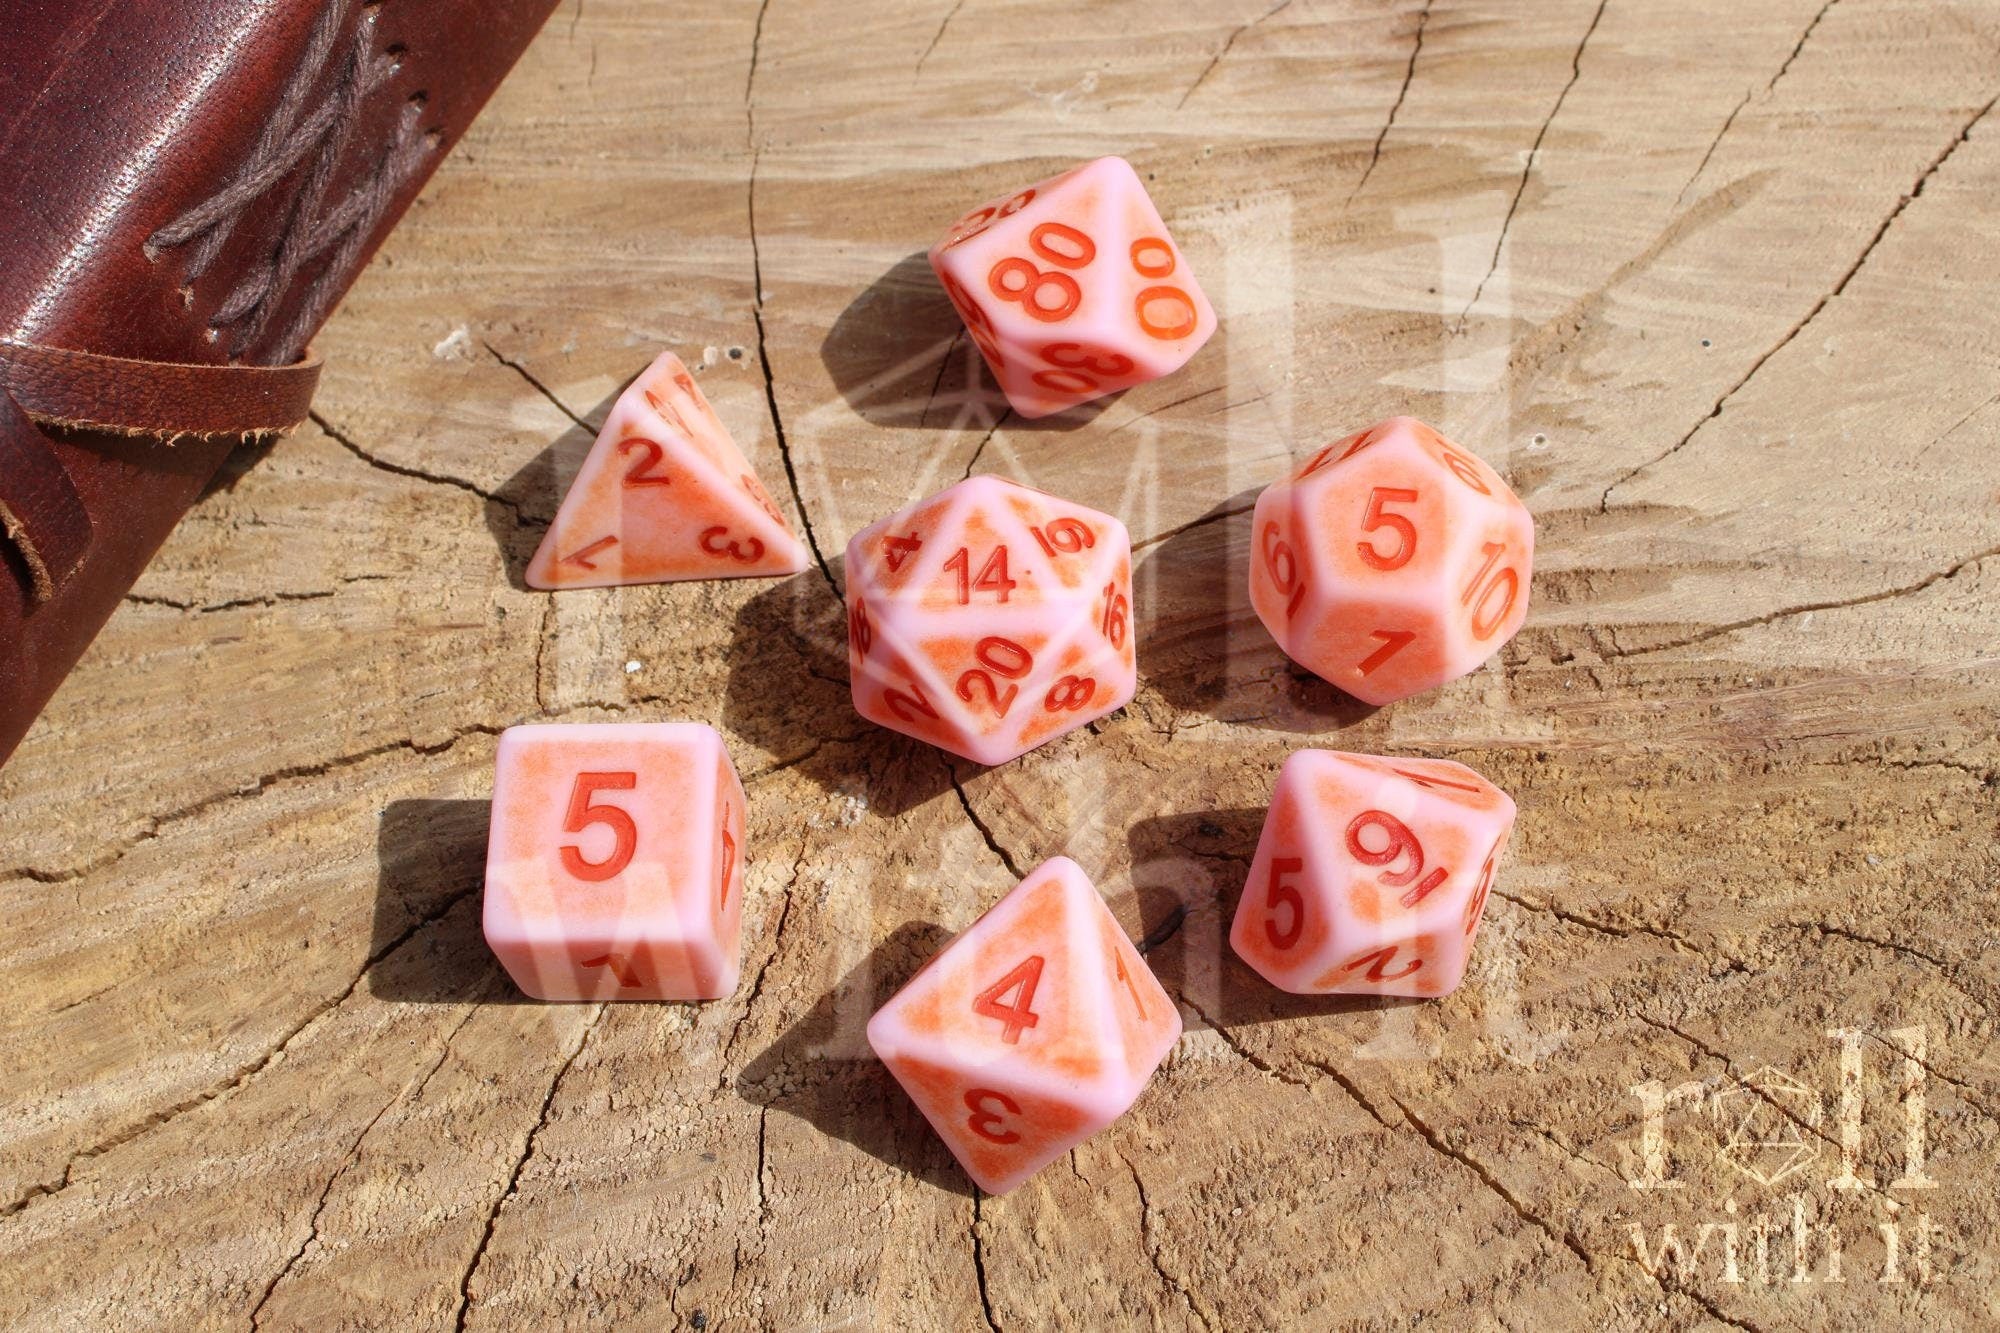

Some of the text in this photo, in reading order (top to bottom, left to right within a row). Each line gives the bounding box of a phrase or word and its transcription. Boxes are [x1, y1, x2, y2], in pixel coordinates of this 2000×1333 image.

[988, 222, 1097, 323] 80
[1130, 237, 1198, 340] 00
[1032, 342, 1134, 393] 30
[617, 437, 671, 488] 2
[560, 535, 619, 571] 1
[699, 526, 765, 565] 3
[881, 531, 922, 573] 4
[1357, 487, 1418, 571] 5
[943, 545, 1016, 605] 14
[1462, 542, 1518, 641] 10
[1103, 582, 1128, 650] 16
[956, 636, 1033, 719] 20
[1357, 630, 1416, 677] 1
[883, 684, 940, 722] 2
[1045, 675, 1095, 712] 8
[559, 771, 637, 882] 5
[1265, 857, 1303, 950] 5
[1115, 946, 1148, 1022] 1
[1339, 945, 1424, 983] 2
[972, 955, 1044, 1045] 4
[963, 1088, 1022, 1145] 3
